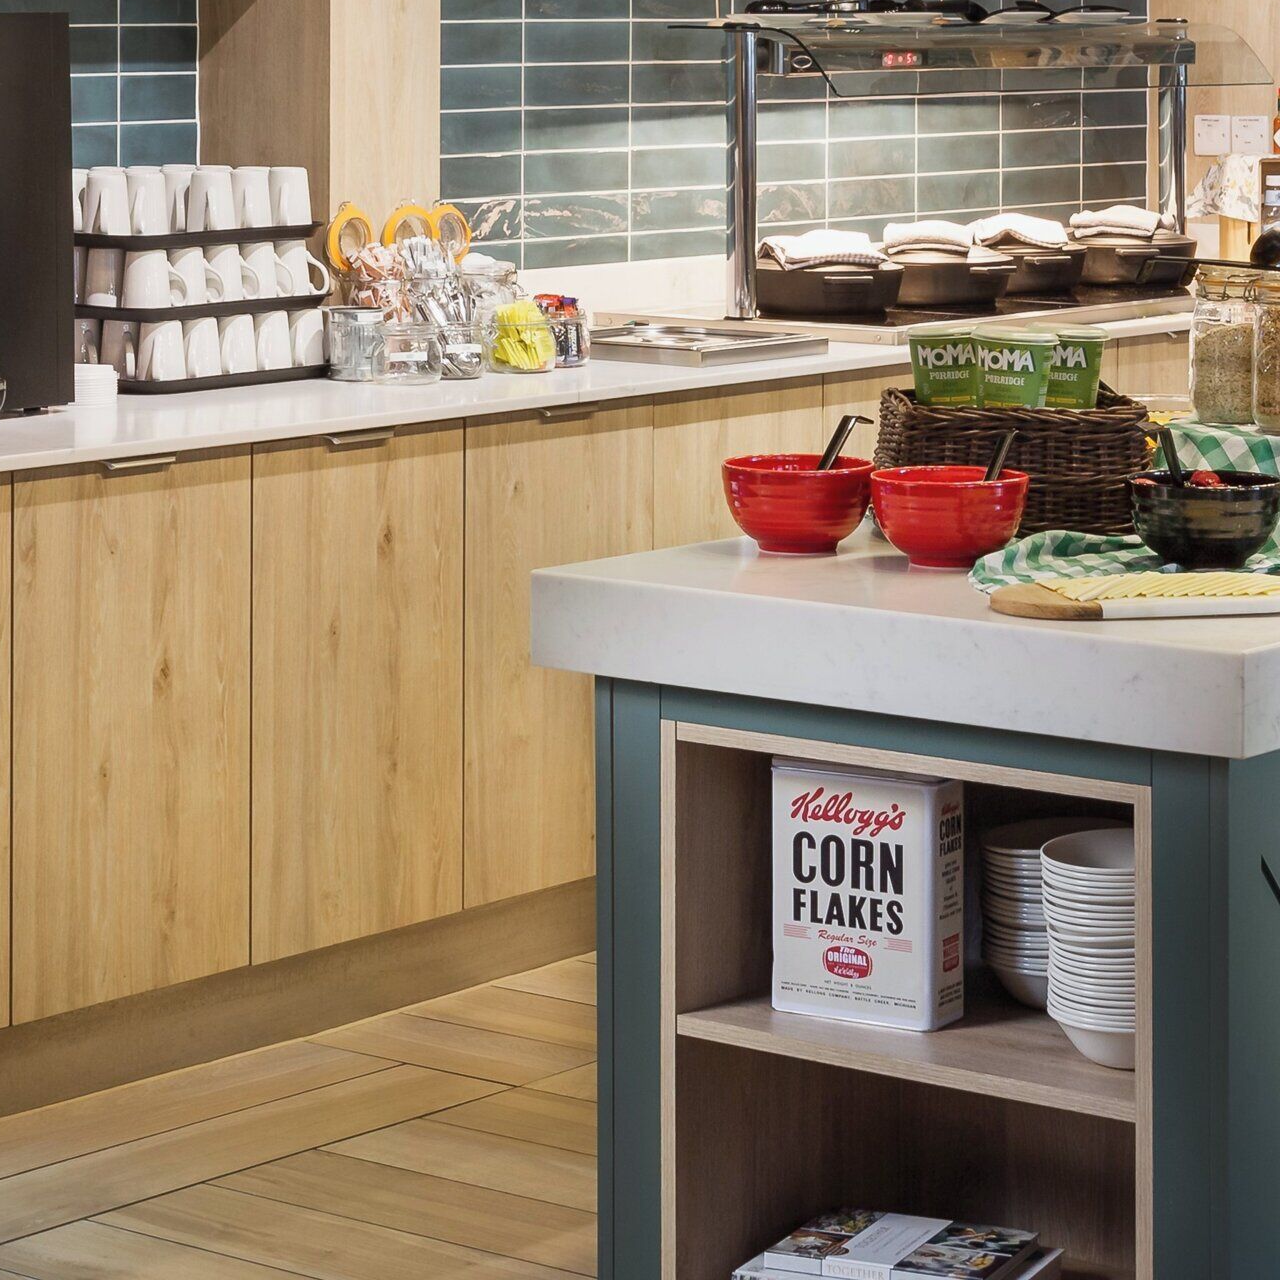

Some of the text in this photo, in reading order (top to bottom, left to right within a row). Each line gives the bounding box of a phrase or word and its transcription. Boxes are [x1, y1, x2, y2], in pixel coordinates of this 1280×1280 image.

[917, 343, 976, 370] MOMA
[977, 345, 1035, 372] MOMA
[1049, 345, 1087, 369] OMA
[929, 371, 970, 381] PORRIDGE
[984, 374, 1025, 386] PORRIDGE
[791, 787, 907, 838] Kellogg's
[939, 813, 962, 841] CORN
[939, 838, 962, 858] FLAKES
[792, 830, 904, 896] CORN
[792, 887, 904, 936] FLAKES
[818, 929, 878, 948] Regular Size
[827, 950, 869, 967] ORIGINAL
[827, 1264, 885, 1280] TOGETHER
